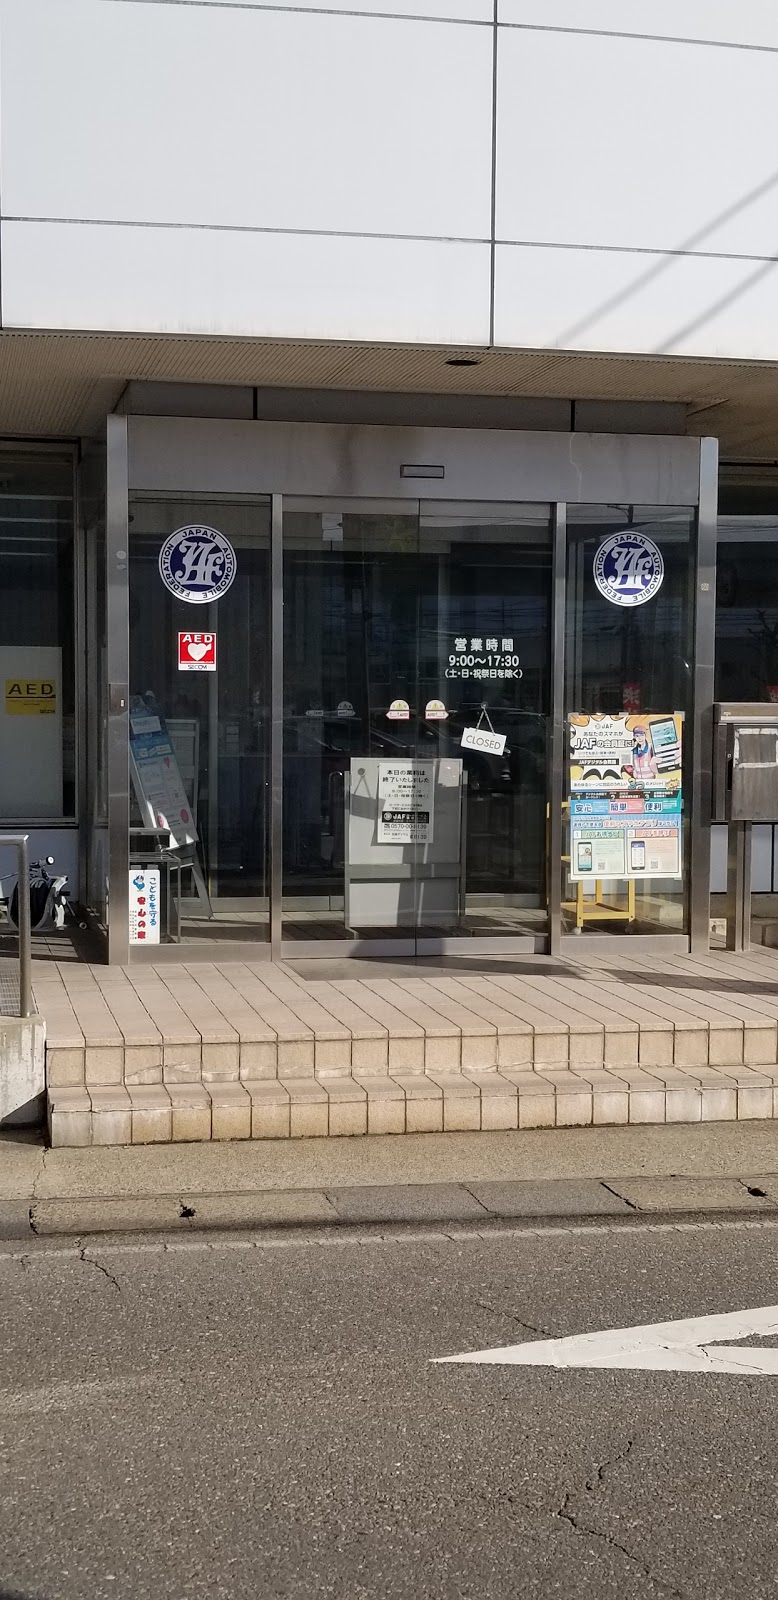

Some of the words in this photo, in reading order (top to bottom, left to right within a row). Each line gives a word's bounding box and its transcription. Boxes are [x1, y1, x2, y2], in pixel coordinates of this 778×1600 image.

[182, 529, 217, 540] JAPAN
[613, 535, 646, 546] JAPAN
[163, 543, 191, 598] FEDERATION
[202, 547, 233, 599] AUTOMOBILE
[596, 549, 623, 601] FEDERATION
[632, 551, 660, 601] AUTOMOBILE
[182, 634, 213, 643] AED
[454, 637, 514, 652] 営業時間
[8, 683, 54, 695] AED
[465, 735, 501, 750] CLOSED
[575, 804, 593, 813] 安心
[645, 802, 662, 811] 便利
